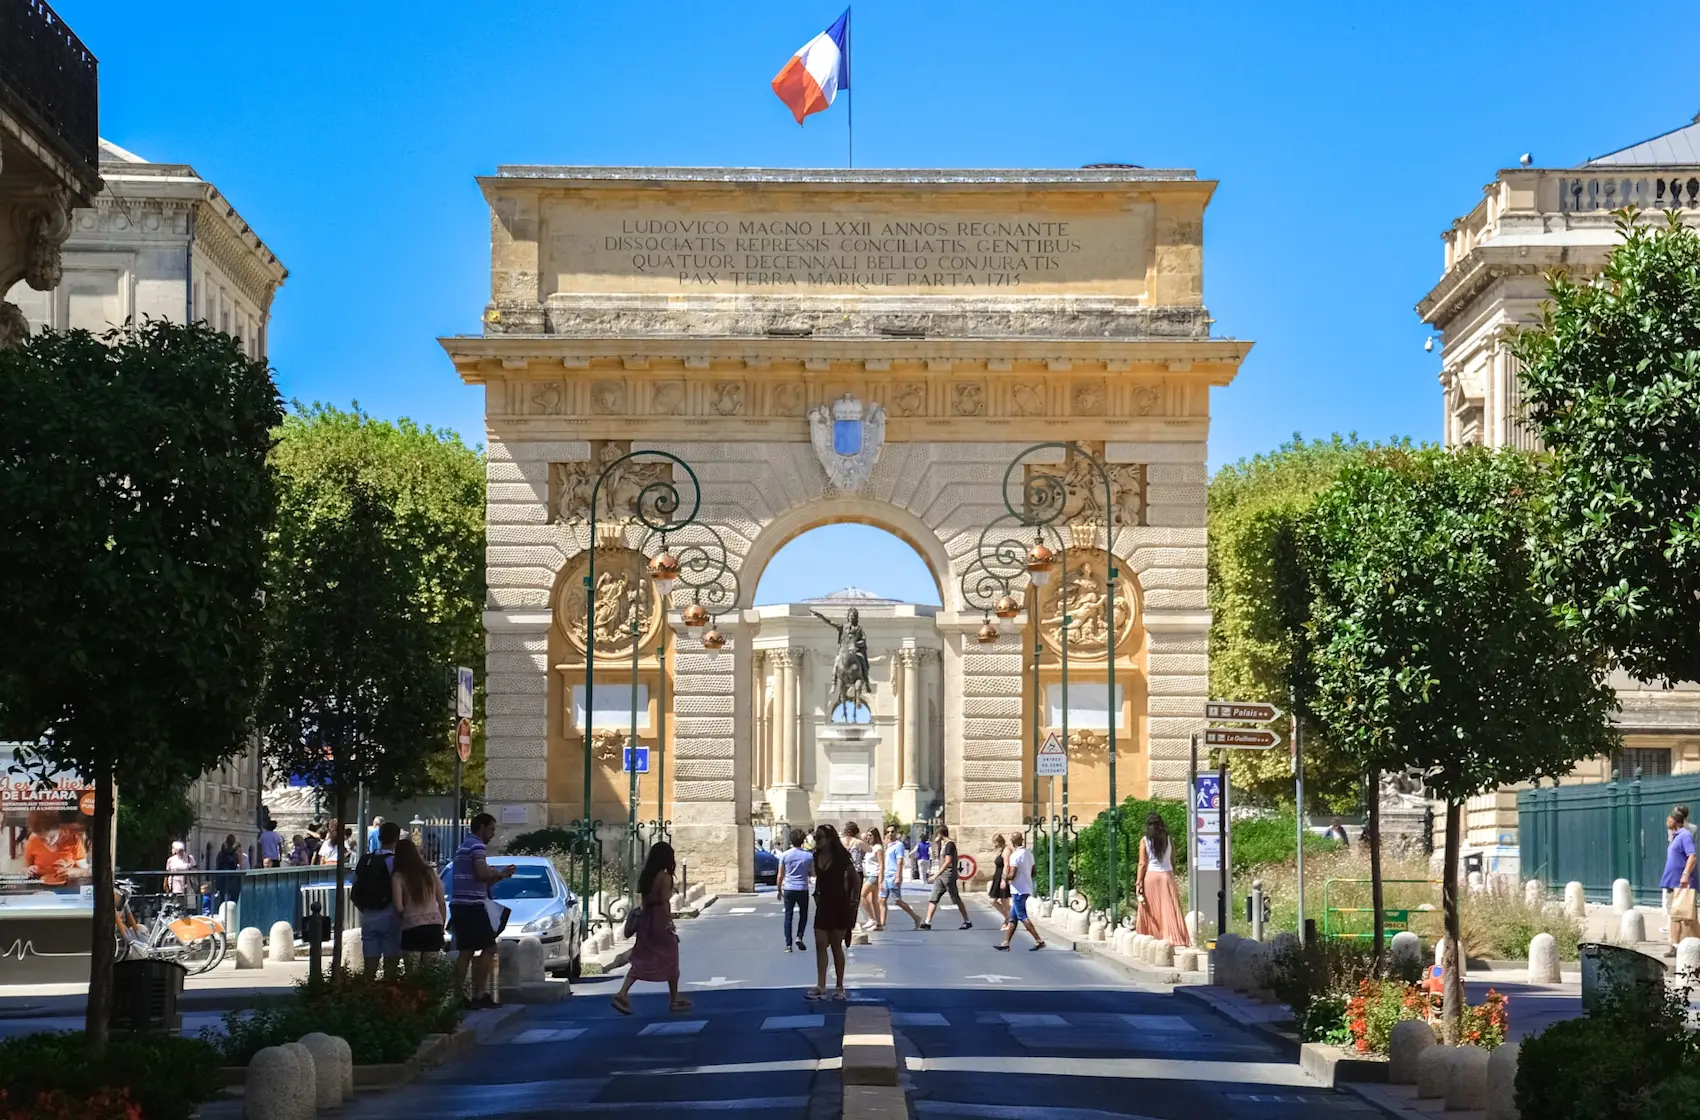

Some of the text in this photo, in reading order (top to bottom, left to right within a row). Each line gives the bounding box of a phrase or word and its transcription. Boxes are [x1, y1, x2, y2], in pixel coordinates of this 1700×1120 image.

[622, 220, 1070, 237] LUDOVICO MAGNO LXXII ANNOS REGNANTE
[604, 236, 1081, 253] DISSOCIATIS REPRESSIS CONCILIATIS GENTIBUS
[632, 254, 1060, 272] QUATUOR DECENNALI BELLO CONJURATIS
[678, 271, 719, 285] PAX
[729, 272, 798, 286] TERRA
[807, 272, 897, 289] MARIQUE
[907, 273, 977, 287] PARTA
[1233, 708, 1258, 717] Palais
[2, 791, 78, 801] DE LATTARA
